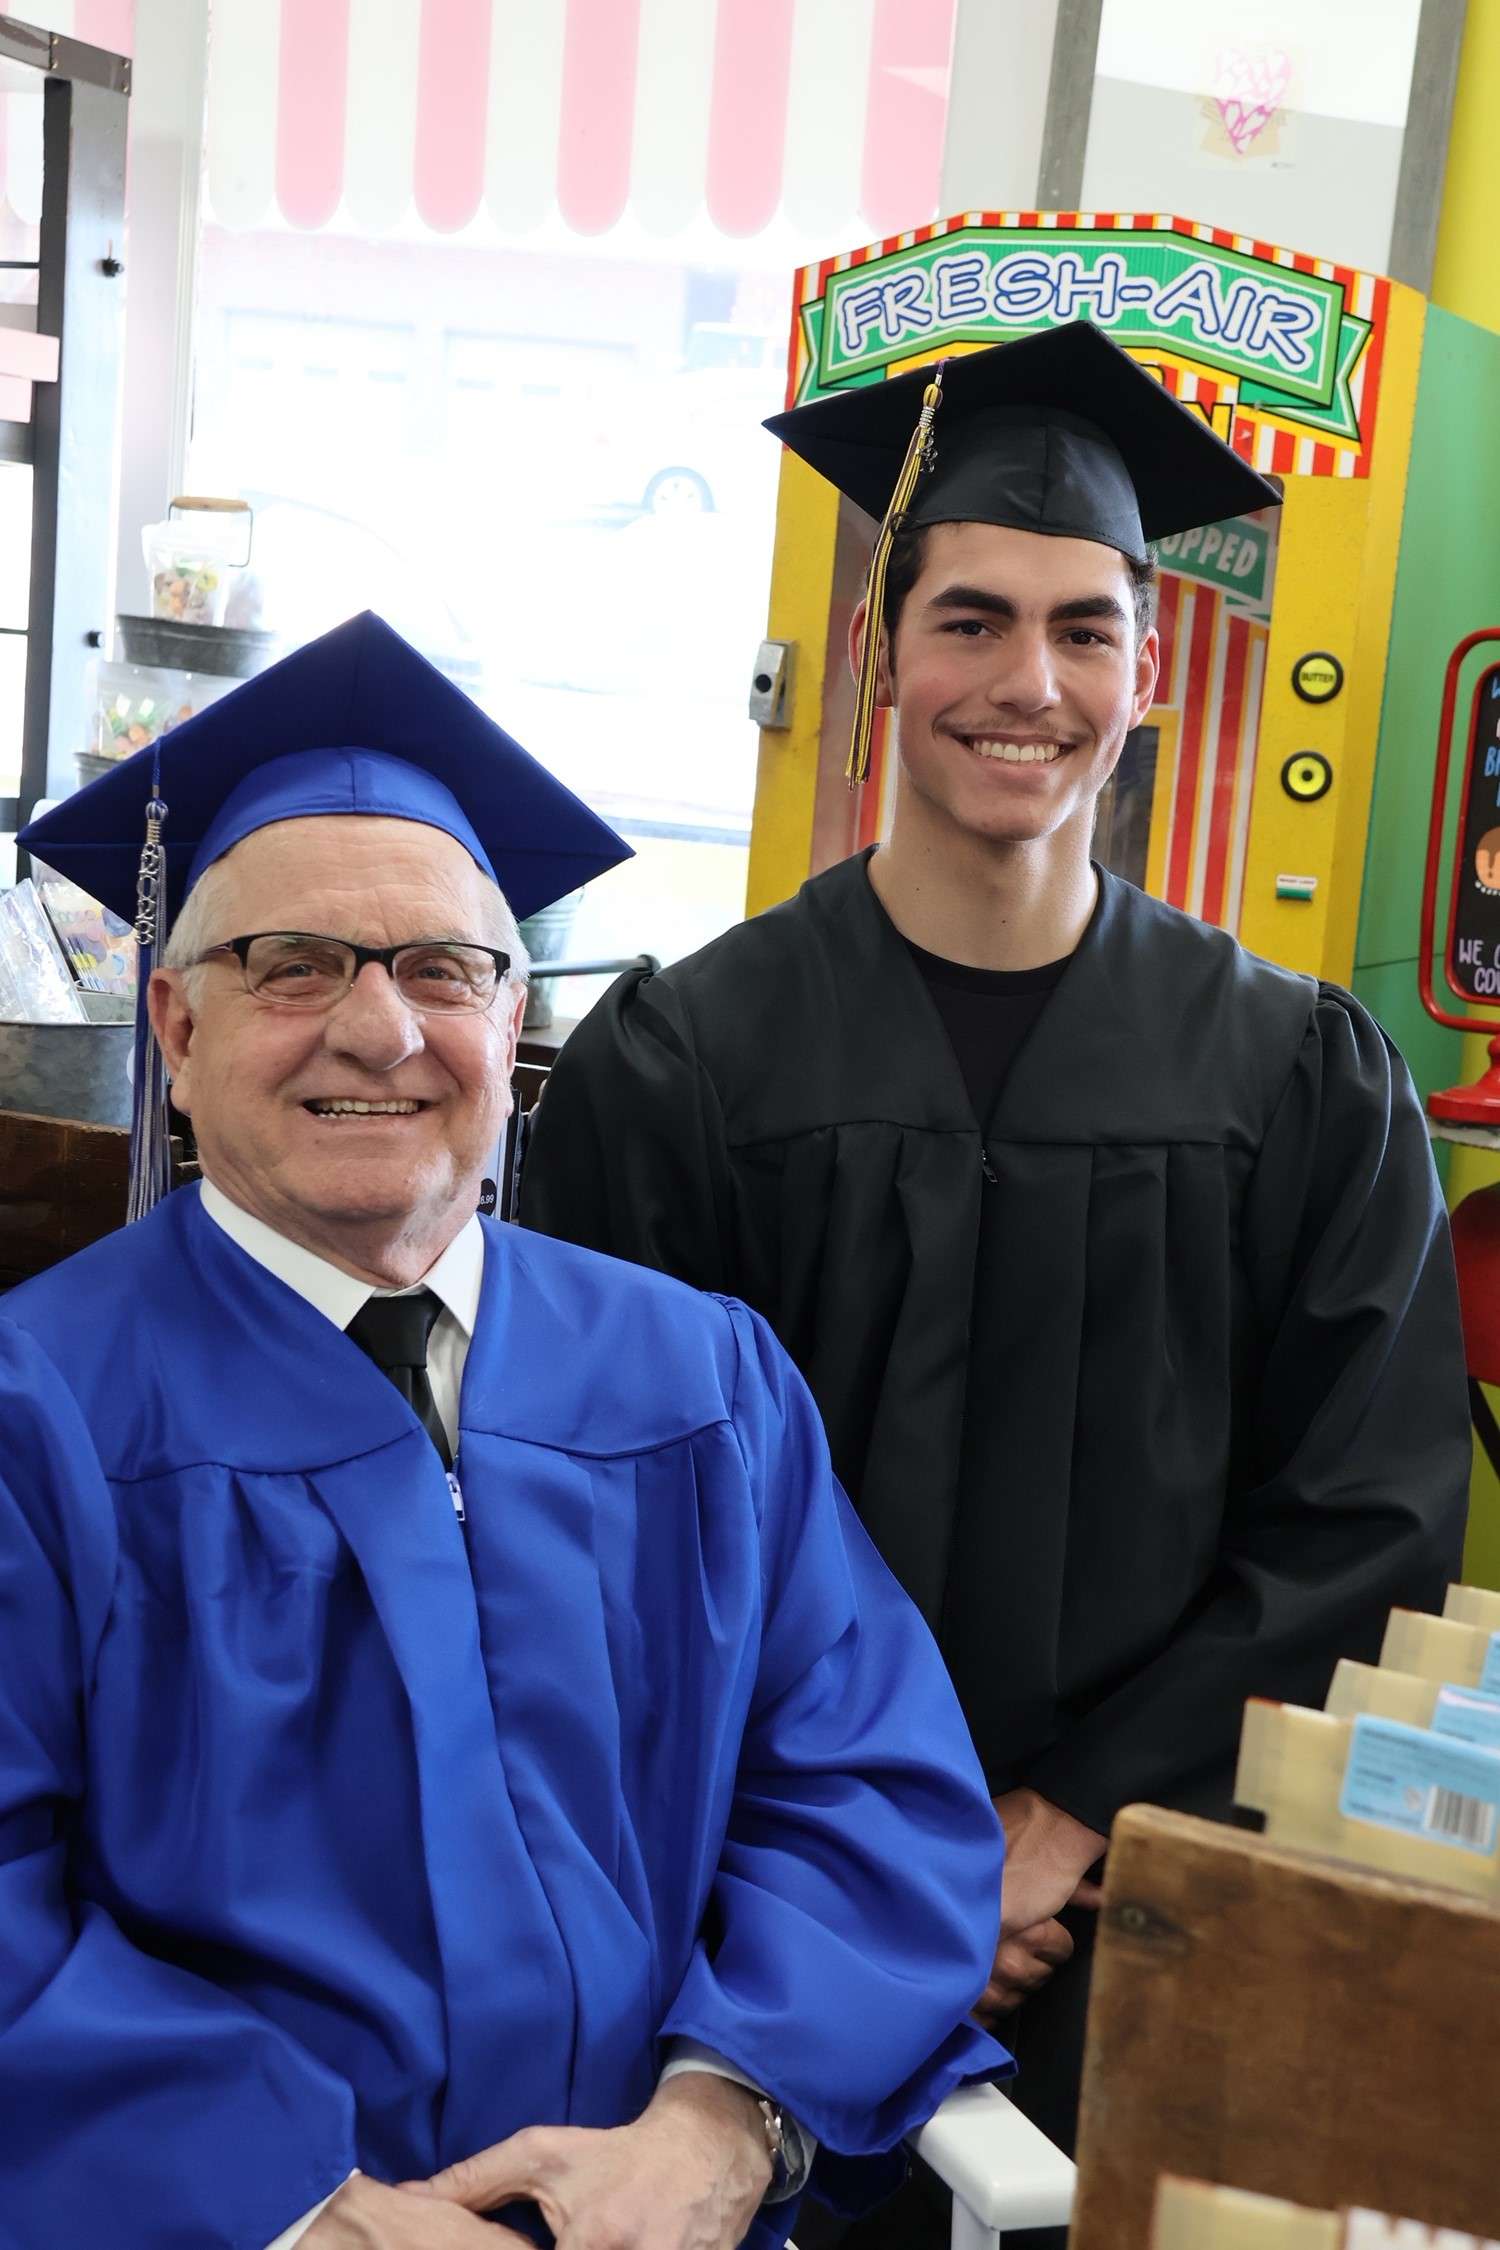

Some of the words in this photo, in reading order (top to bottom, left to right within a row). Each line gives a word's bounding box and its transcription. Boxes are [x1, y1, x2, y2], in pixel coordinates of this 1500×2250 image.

[838, 253, 1316, 369] FRESH-AIR
[1301, 671, 1335, 684] BUTTER
[1459, 938, 1484, 966] WE
